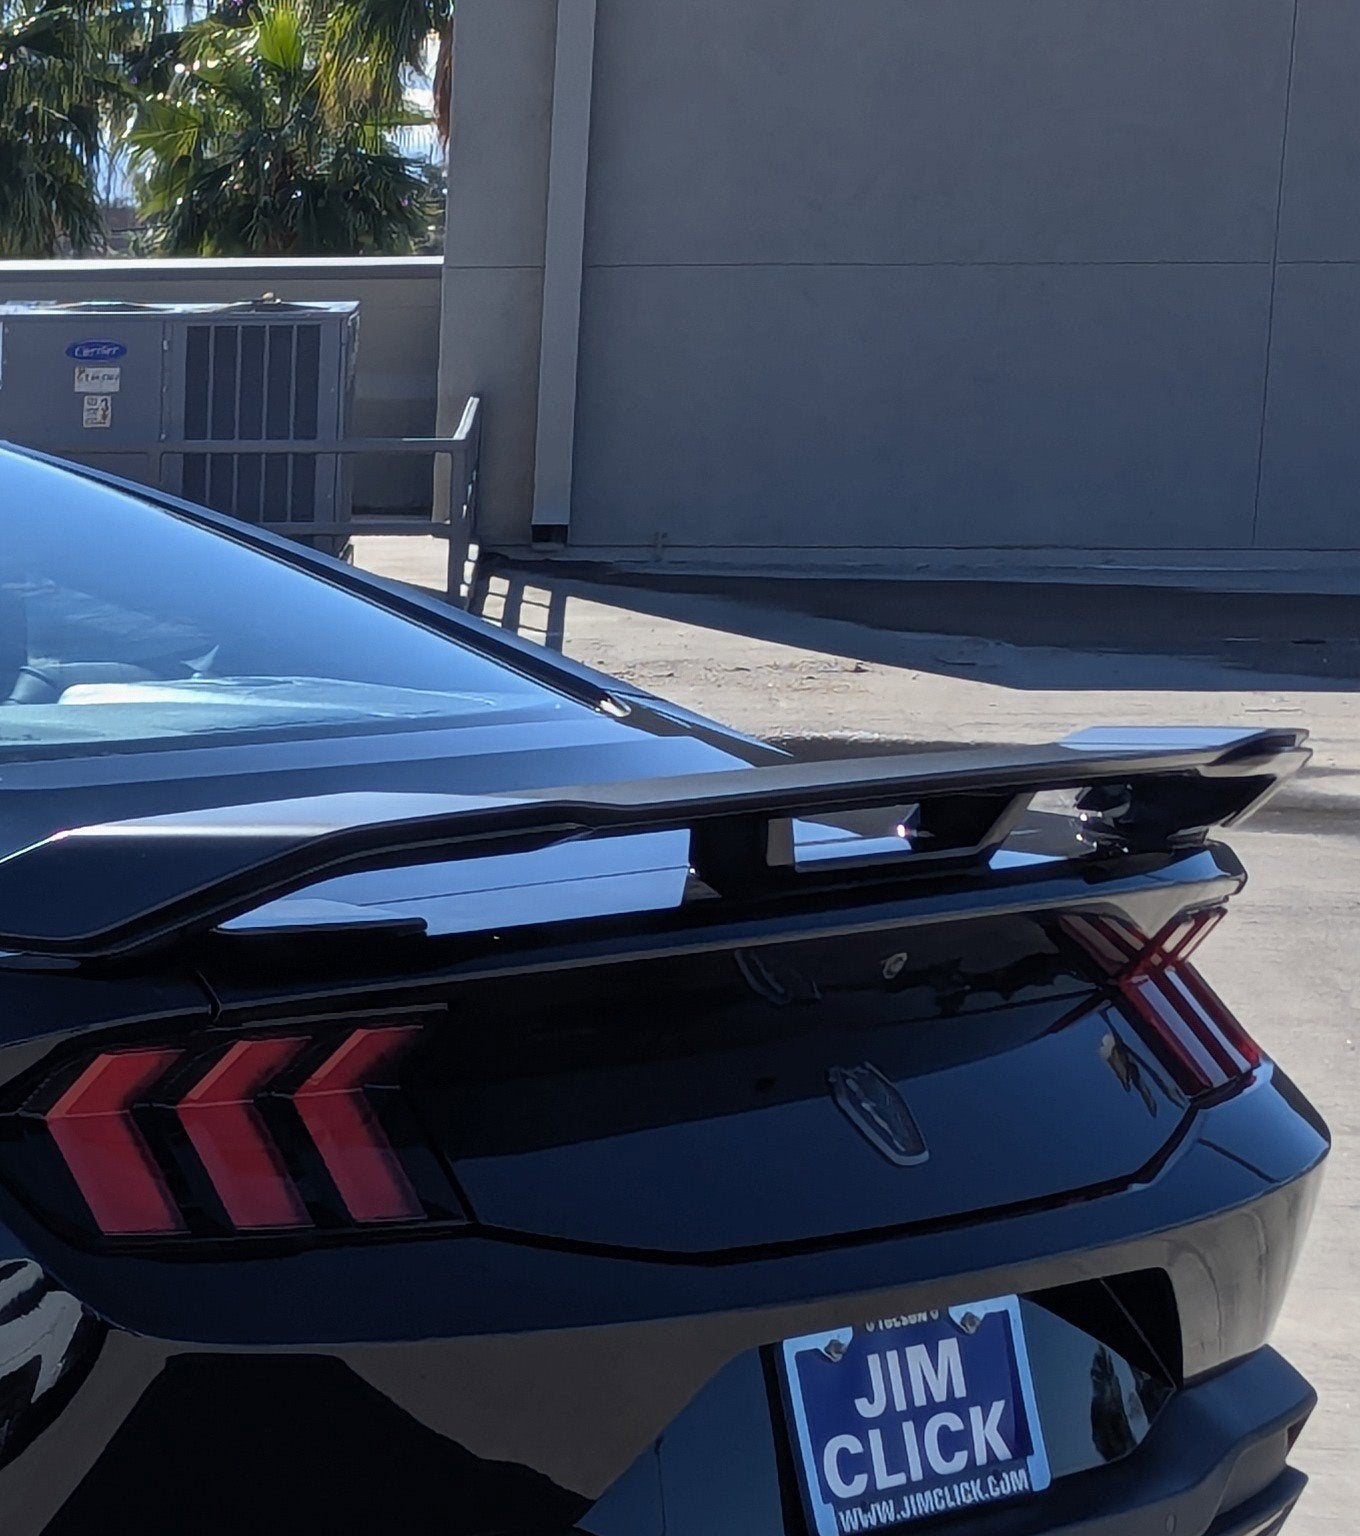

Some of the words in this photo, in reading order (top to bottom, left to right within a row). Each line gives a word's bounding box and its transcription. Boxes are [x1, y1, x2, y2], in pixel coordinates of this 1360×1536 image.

[853, 1337, 967, 1419] JIM
[823, 1399, 1012, 1499] CLICK
[838, 1468, 1030, 1533] WWW.JIMCLICK.COM
